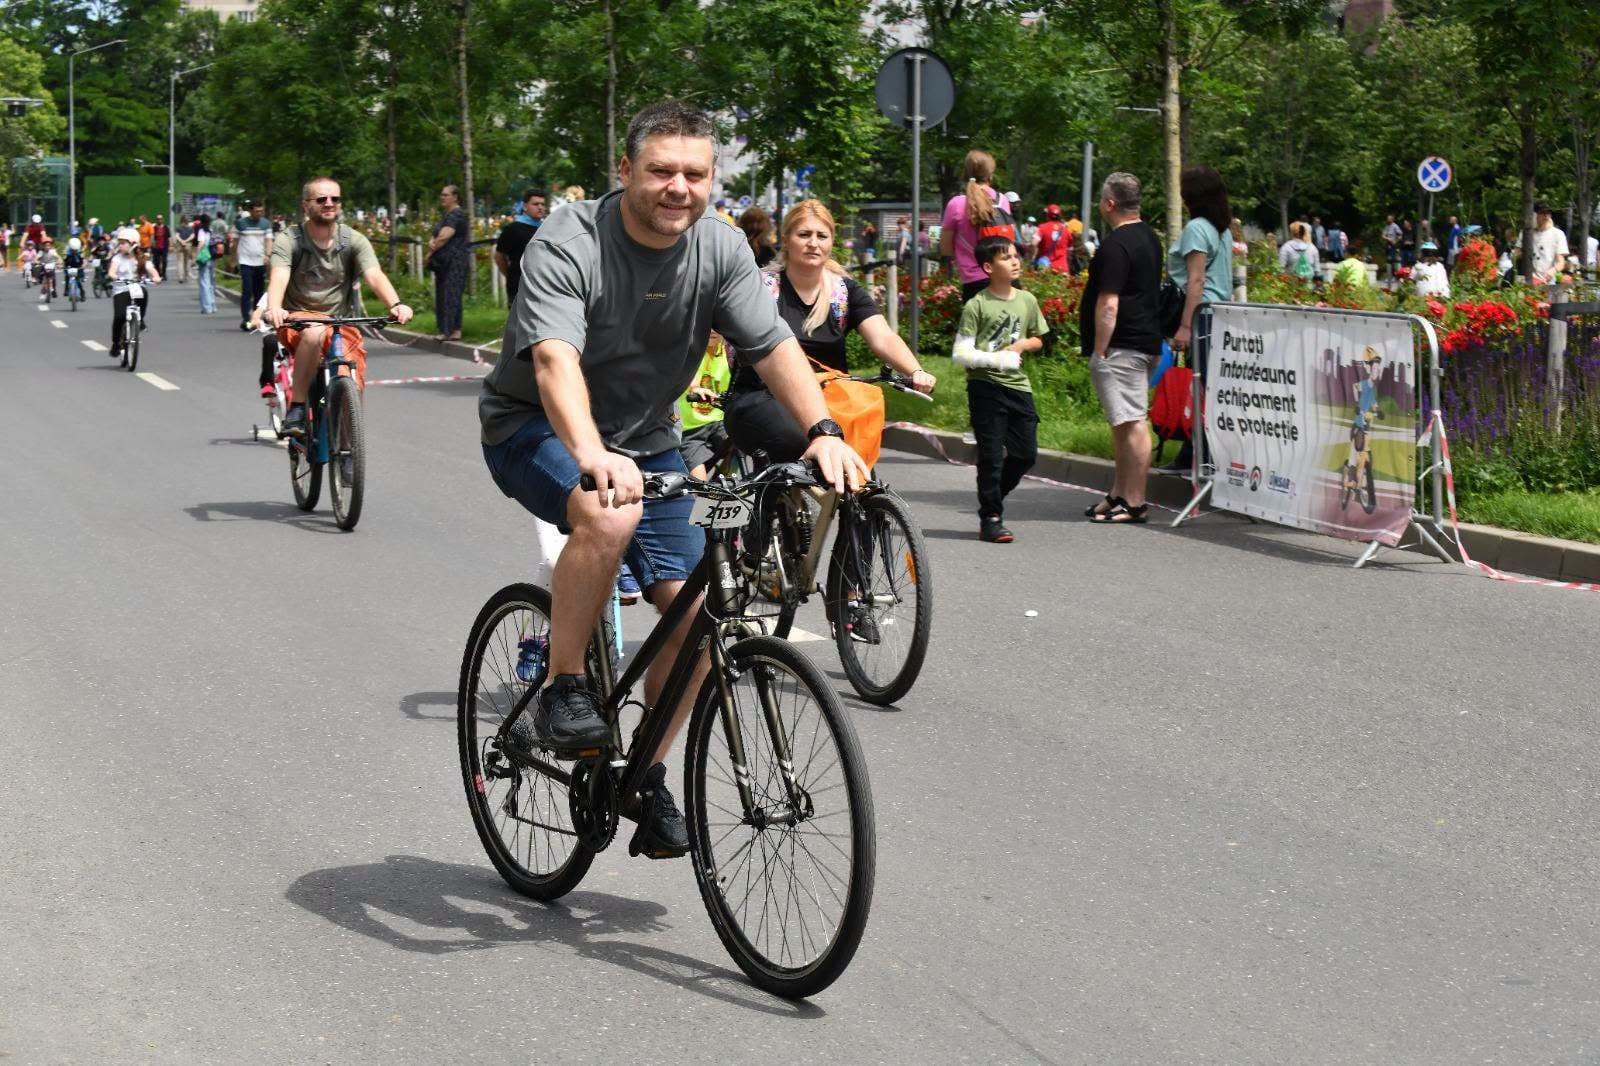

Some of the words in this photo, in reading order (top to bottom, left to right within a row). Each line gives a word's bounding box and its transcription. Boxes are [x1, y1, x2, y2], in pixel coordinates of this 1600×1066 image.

[1217, 387, 1297, 413] echipament
[1217, 412, 1235, 432] de
[705, 505, 742, 519] 2139
